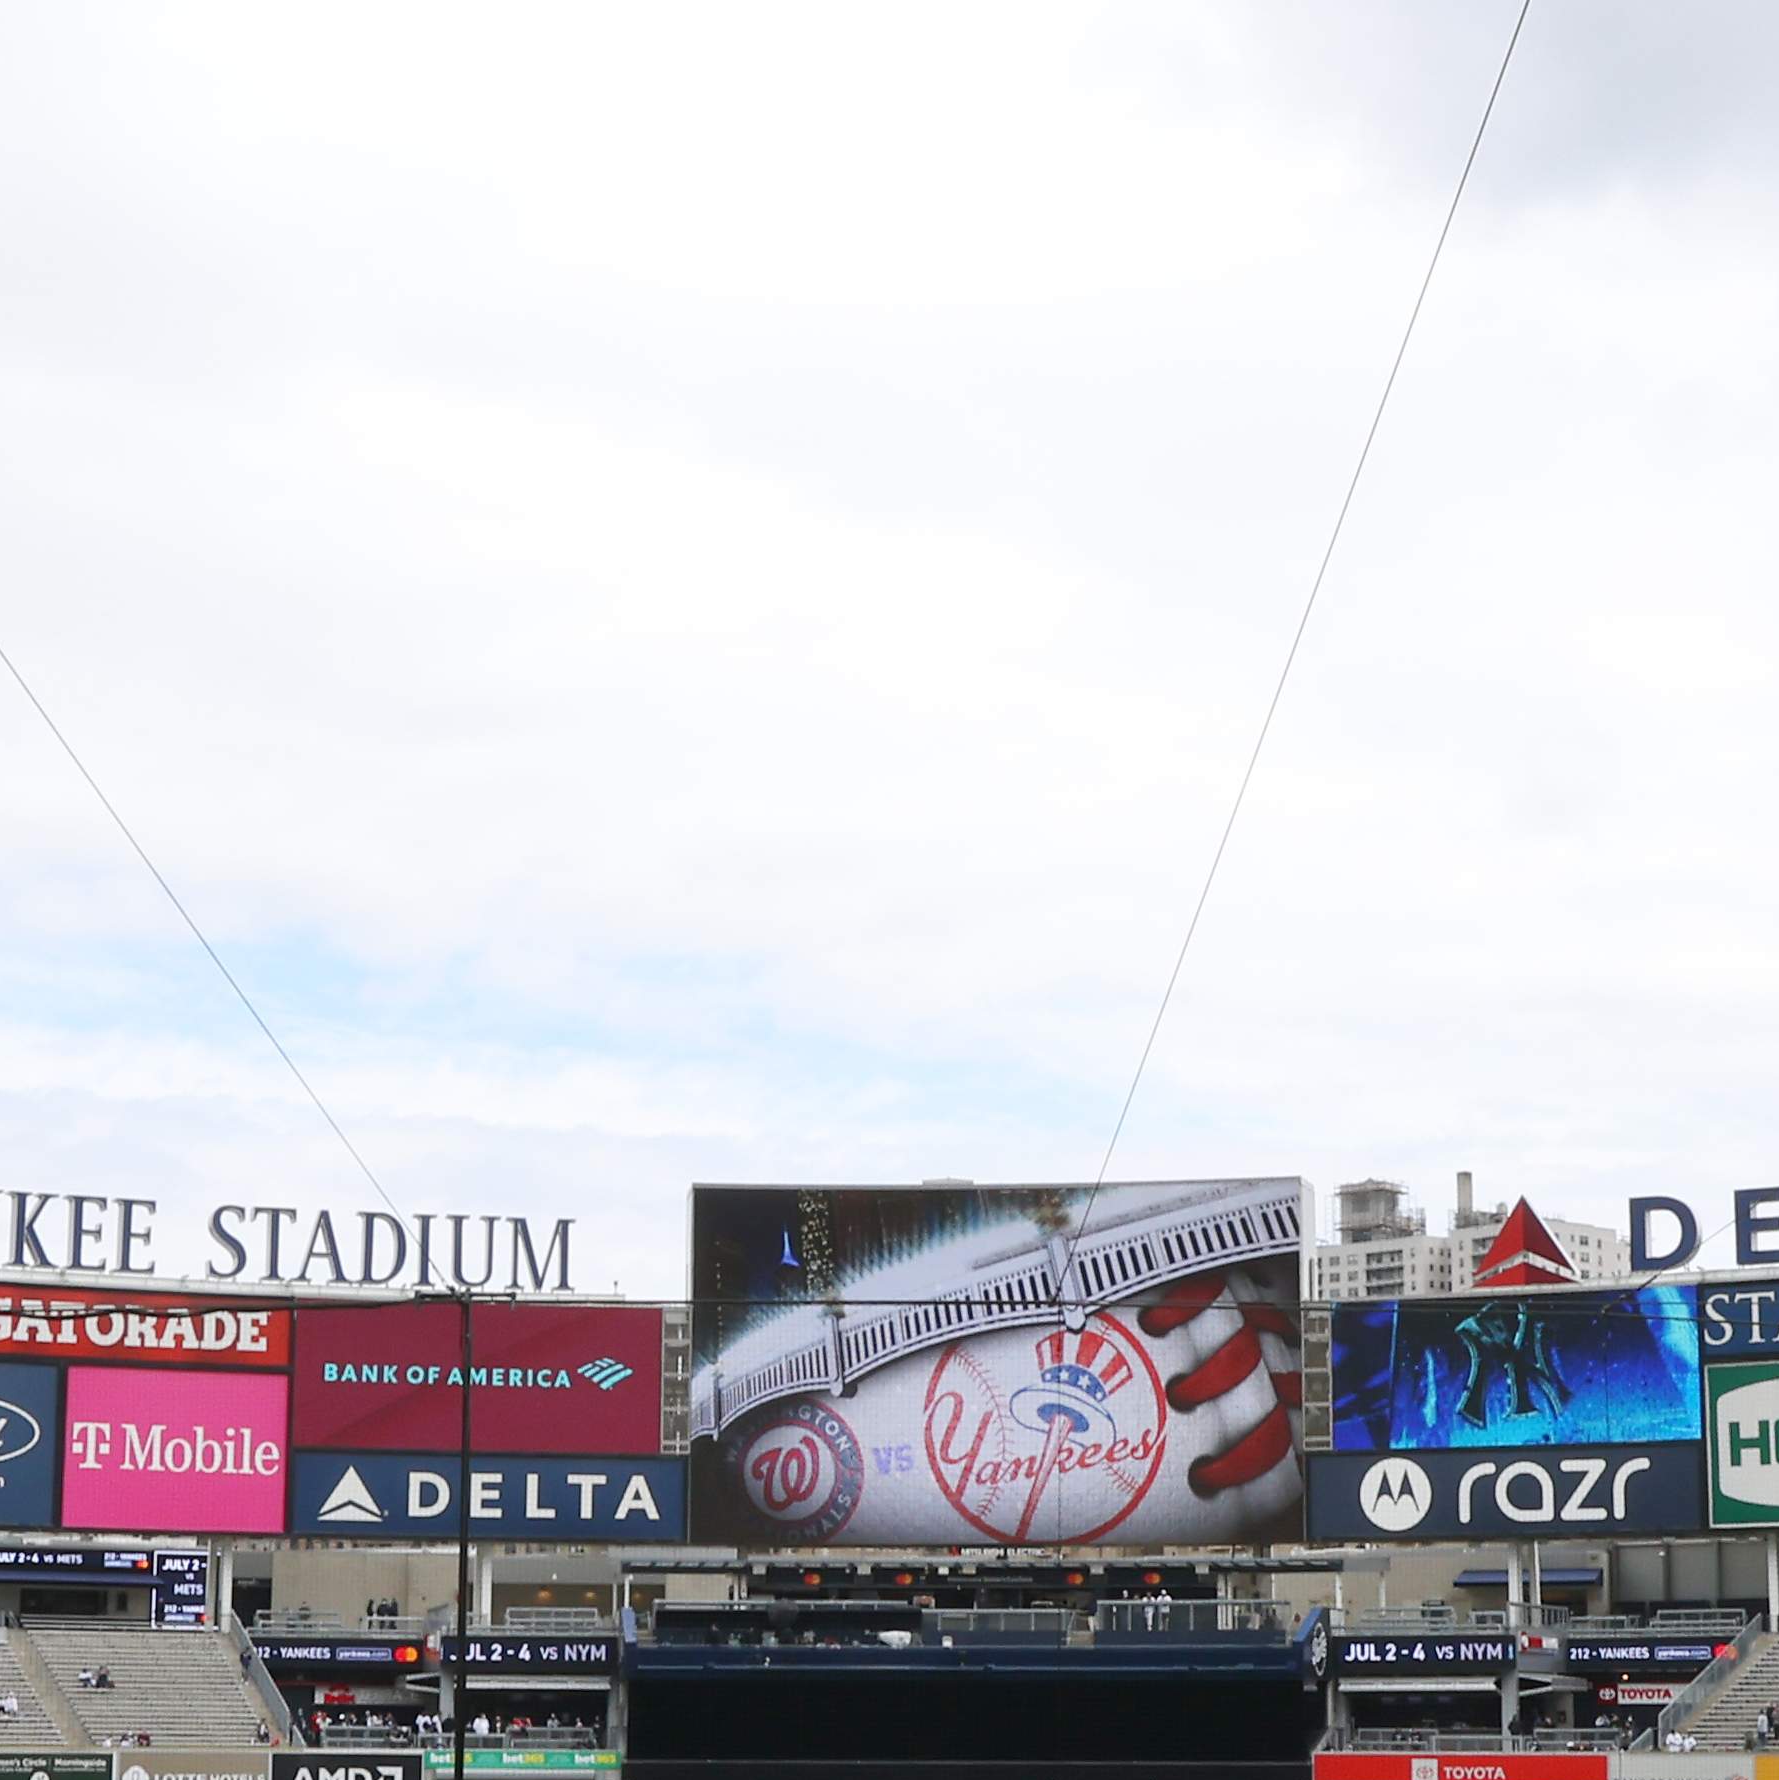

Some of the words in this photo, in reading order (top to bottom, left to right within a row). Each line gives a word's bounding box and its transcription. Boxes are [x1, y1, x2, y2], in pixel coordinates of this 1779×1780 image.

[206, 1204, 576, 1292] STADIUM
[323, 1362, 398, 1385] BANK
[406, 1364, 440, 1387] OF
[446, 1366, 571, 1389] AMERICA
[71, 1421, 111, 1469] T
[121, 1421, 281, 1476] Mobile
[925, 1391, 1161, 1500] Yankees
[872, 1444, 916, 1475] VS
[406, 1469, 661, 1521] DELTA
[1458, 1456, 1652, 1525] razr
[56, 1554, 84, 1566] METS
[161, 1558, 190, 1572] JULY
[173, 1584, 204, 1596] METS
[279, 1647, 331, 1660] YANKEES
[490, 1644, 503, 1660] 2
[517, 1644, 531, 1661] 4
[563, 1645, 607, 1662] NYM
[1344, 1642, 1383, 1663] JUL
[1386, 1643, 1399, 1662] 2
[1411, 1643, 1426, 1662] 4
[1460, 1641, 1503, 1661] NYM
[1569, 1648, 1591, 1660] 212
[1598, 1647, 1651, 1660] YANKEES
[1620, 1687, 1674, 1700] TOYOTA
